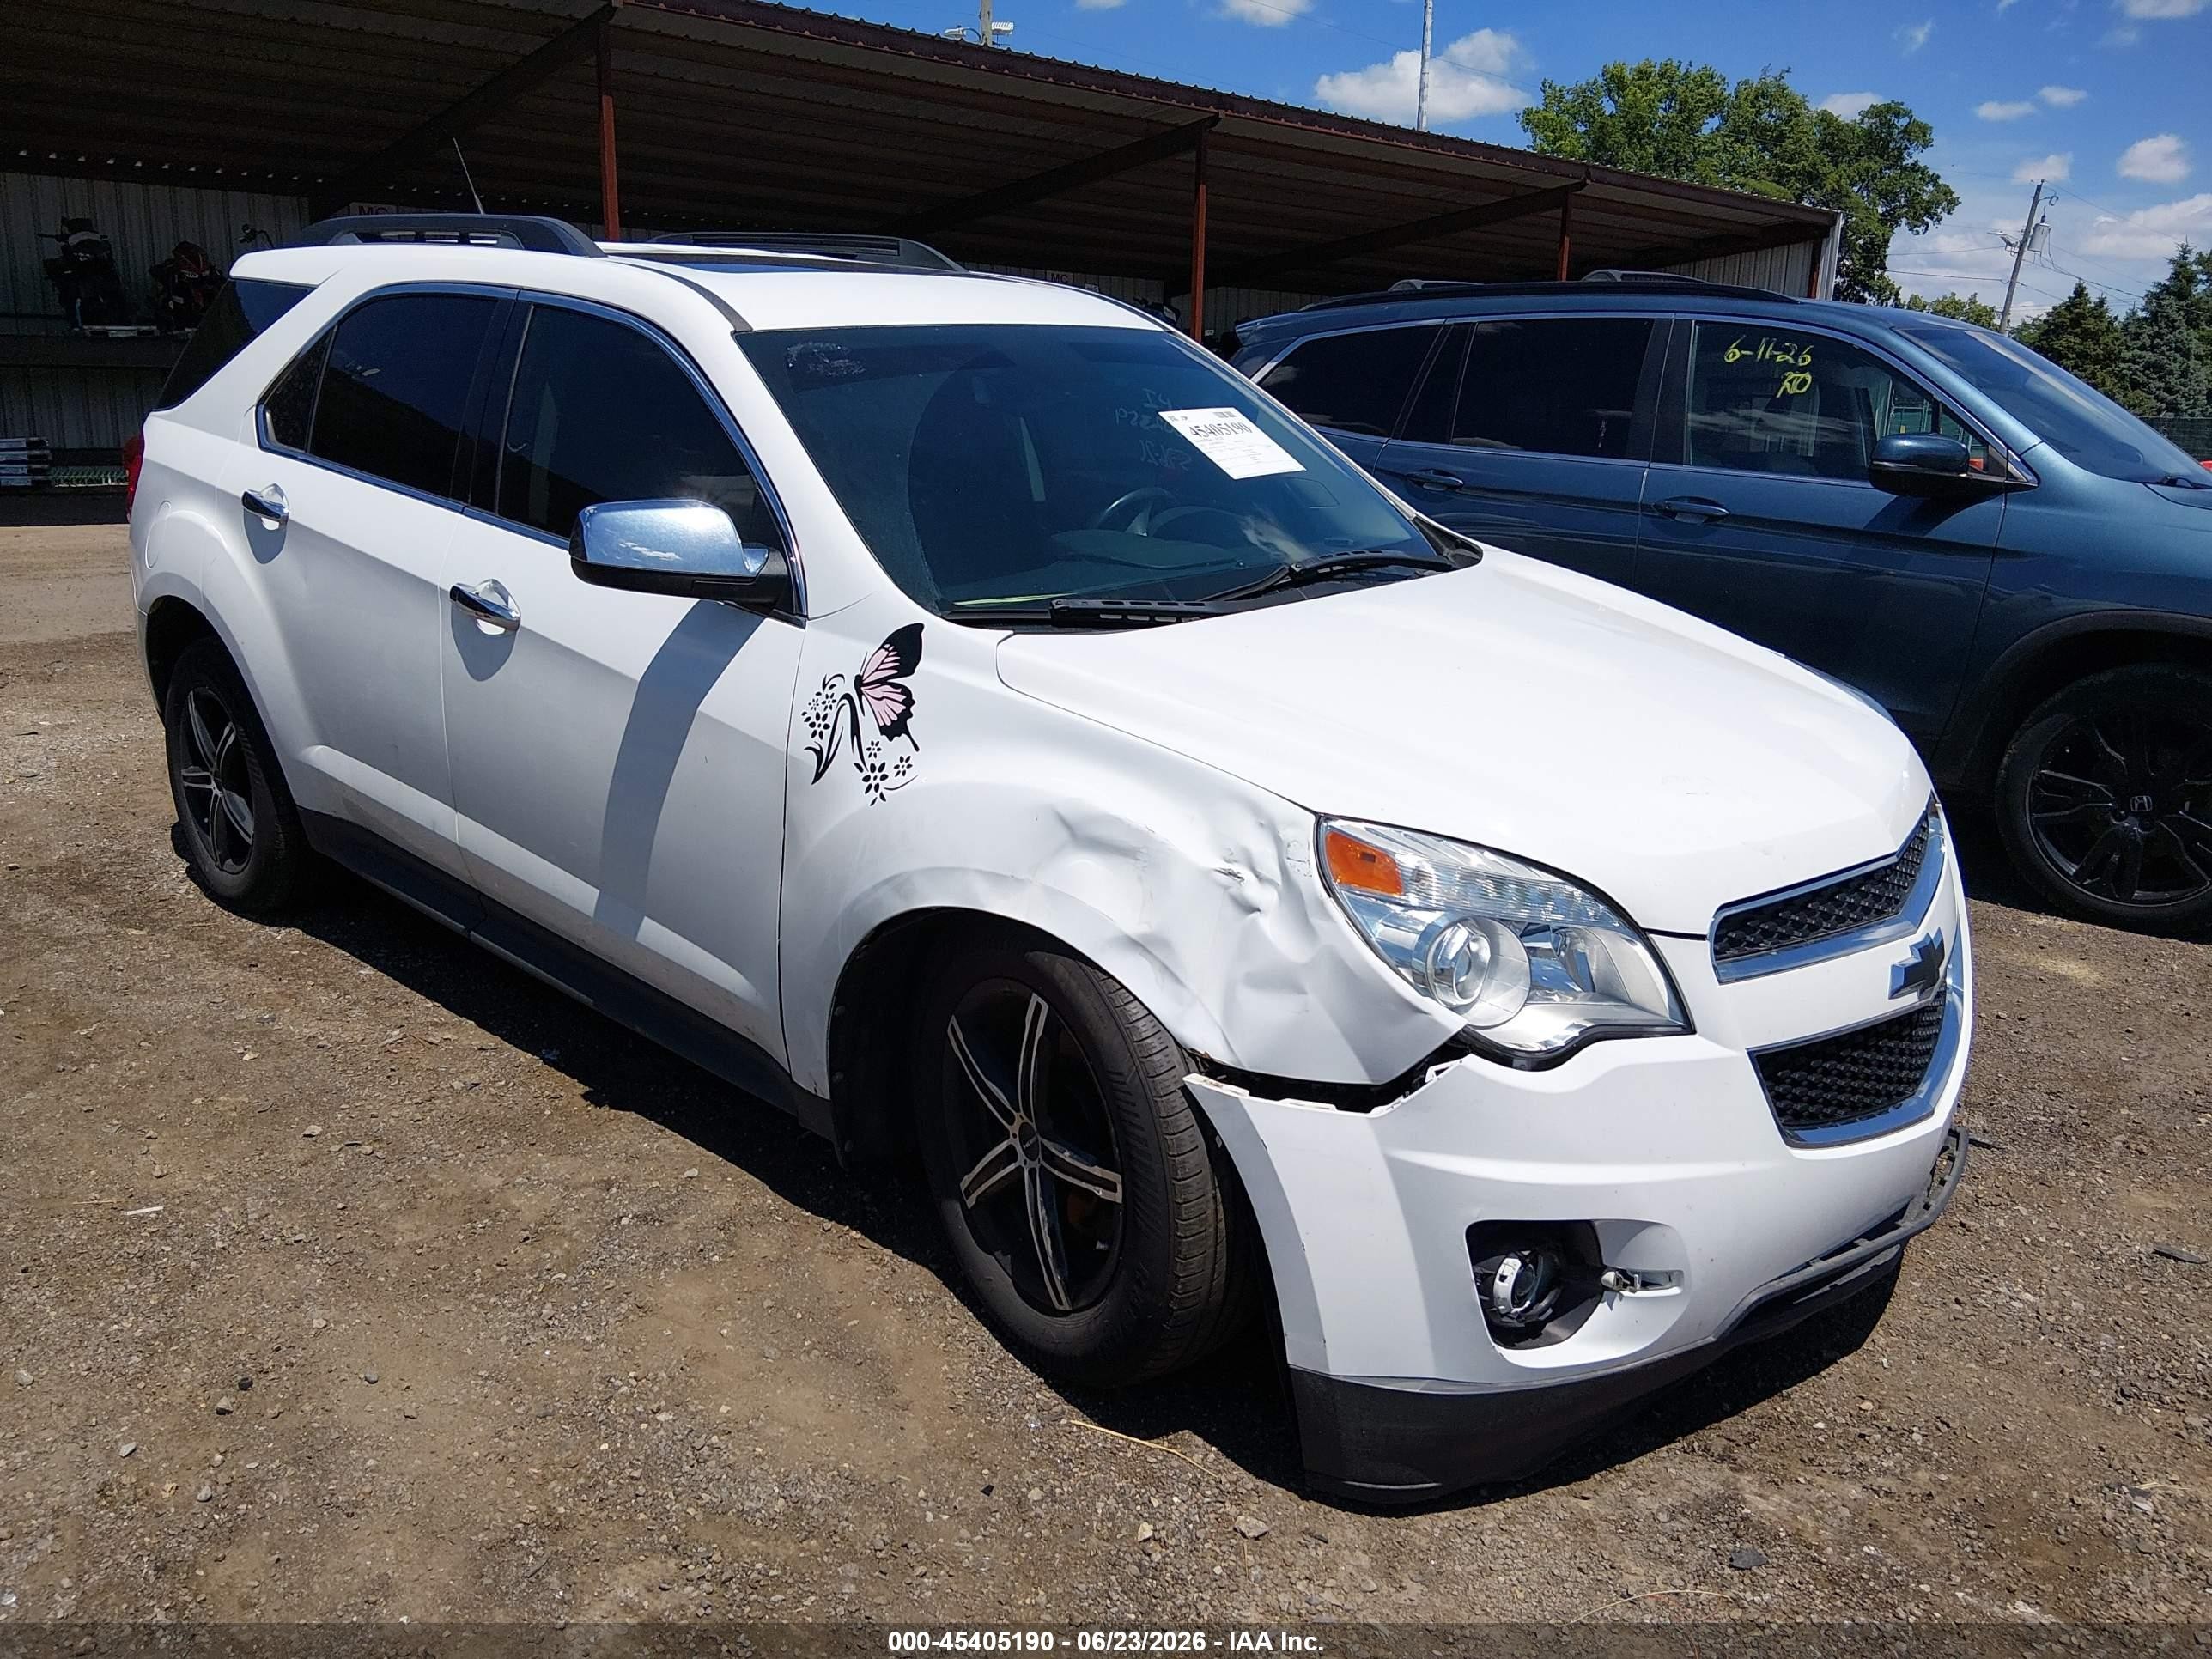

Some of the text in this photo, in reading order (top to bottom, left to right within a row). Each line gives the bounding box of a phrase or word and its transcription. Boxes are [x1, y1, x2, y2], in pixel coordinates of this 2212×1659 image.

[1051, 273, 1068, 283] MC
[1724, 334, 1814, 367] 6-11-26
[1189, 422, 1252, 437] 45405190
